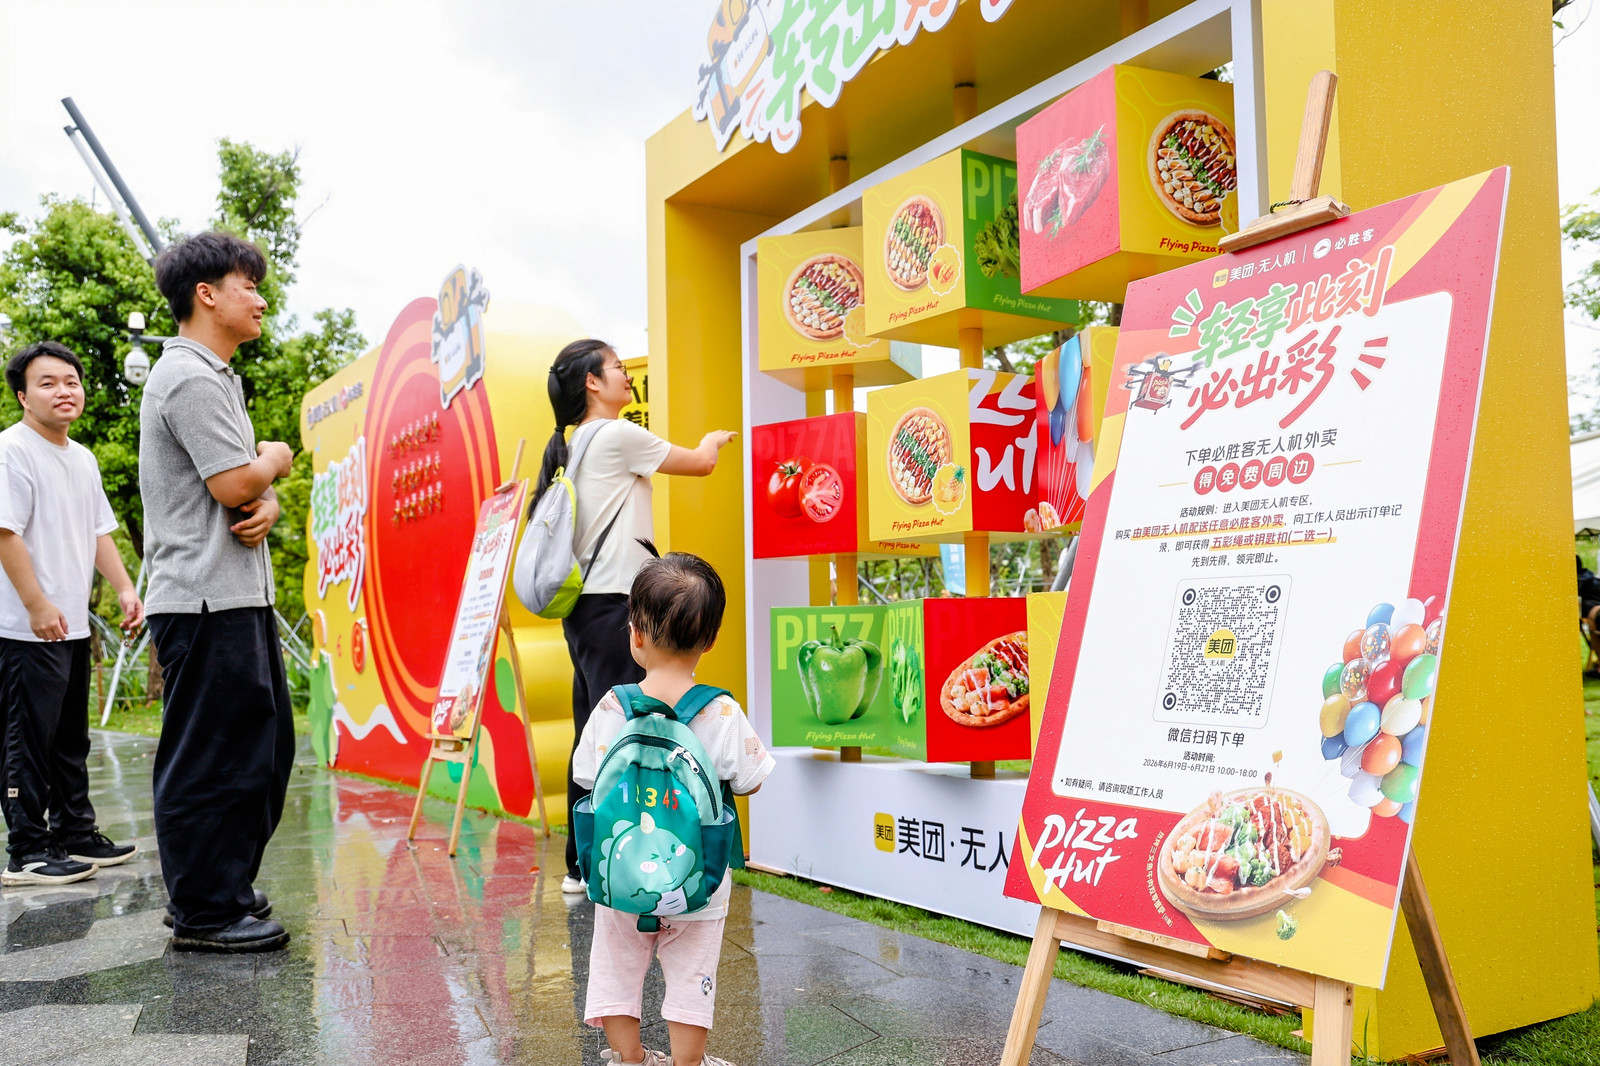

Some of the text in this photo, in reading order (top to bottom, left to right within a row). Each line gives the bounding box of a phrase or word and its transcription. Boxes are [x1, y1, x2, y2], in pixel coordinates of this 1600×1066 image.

[1159, 237, 1189, 254] Flying
[1190, 241, 1217, 254] Pizza
[1229, 249, 1297, 283] 美团·无人机
[1334, 228, 1375, 251] 必胜客
[888, 300, 940, 324] Flying Pizza Hut
[993, 294, 1052, 313] Flying Pizza Hut
[1192, 245, 1394, 368] 轻享此刻
[790, 350, 858, 364] Flying Pizza Hut
[1179, 325, 1342, 431] 必出彩
[1185, 428, 1338, 466] 下单必胜客无人机外卖
[1197, 458, 1310, 490] 得免费周边
[891, 518, 945, 532] Flying Pizza Hut
[1115, 529, 1132, 541] 购买
[1191, 552, 1279, 568] 先到先得，领完即止。
[1207, 638, 1234, 654] 美团
[1210, 659, 1226, 667] 无人机
[805, 730, 877, 742] Flying Pizza Hut
[1167, 727, 1245, 748] 微信扫码下单
[1183, 750, 1216, 763] 活动时间:
[1142, 758, 1258, 779] 2026年6月19日-6月21日 10:00-18:00
[875, 815, 1009, 873] 美团 美团·无人
[1030, 807, 1139, 869] Pizza
[1042, 847, 1122, 895] Hut
